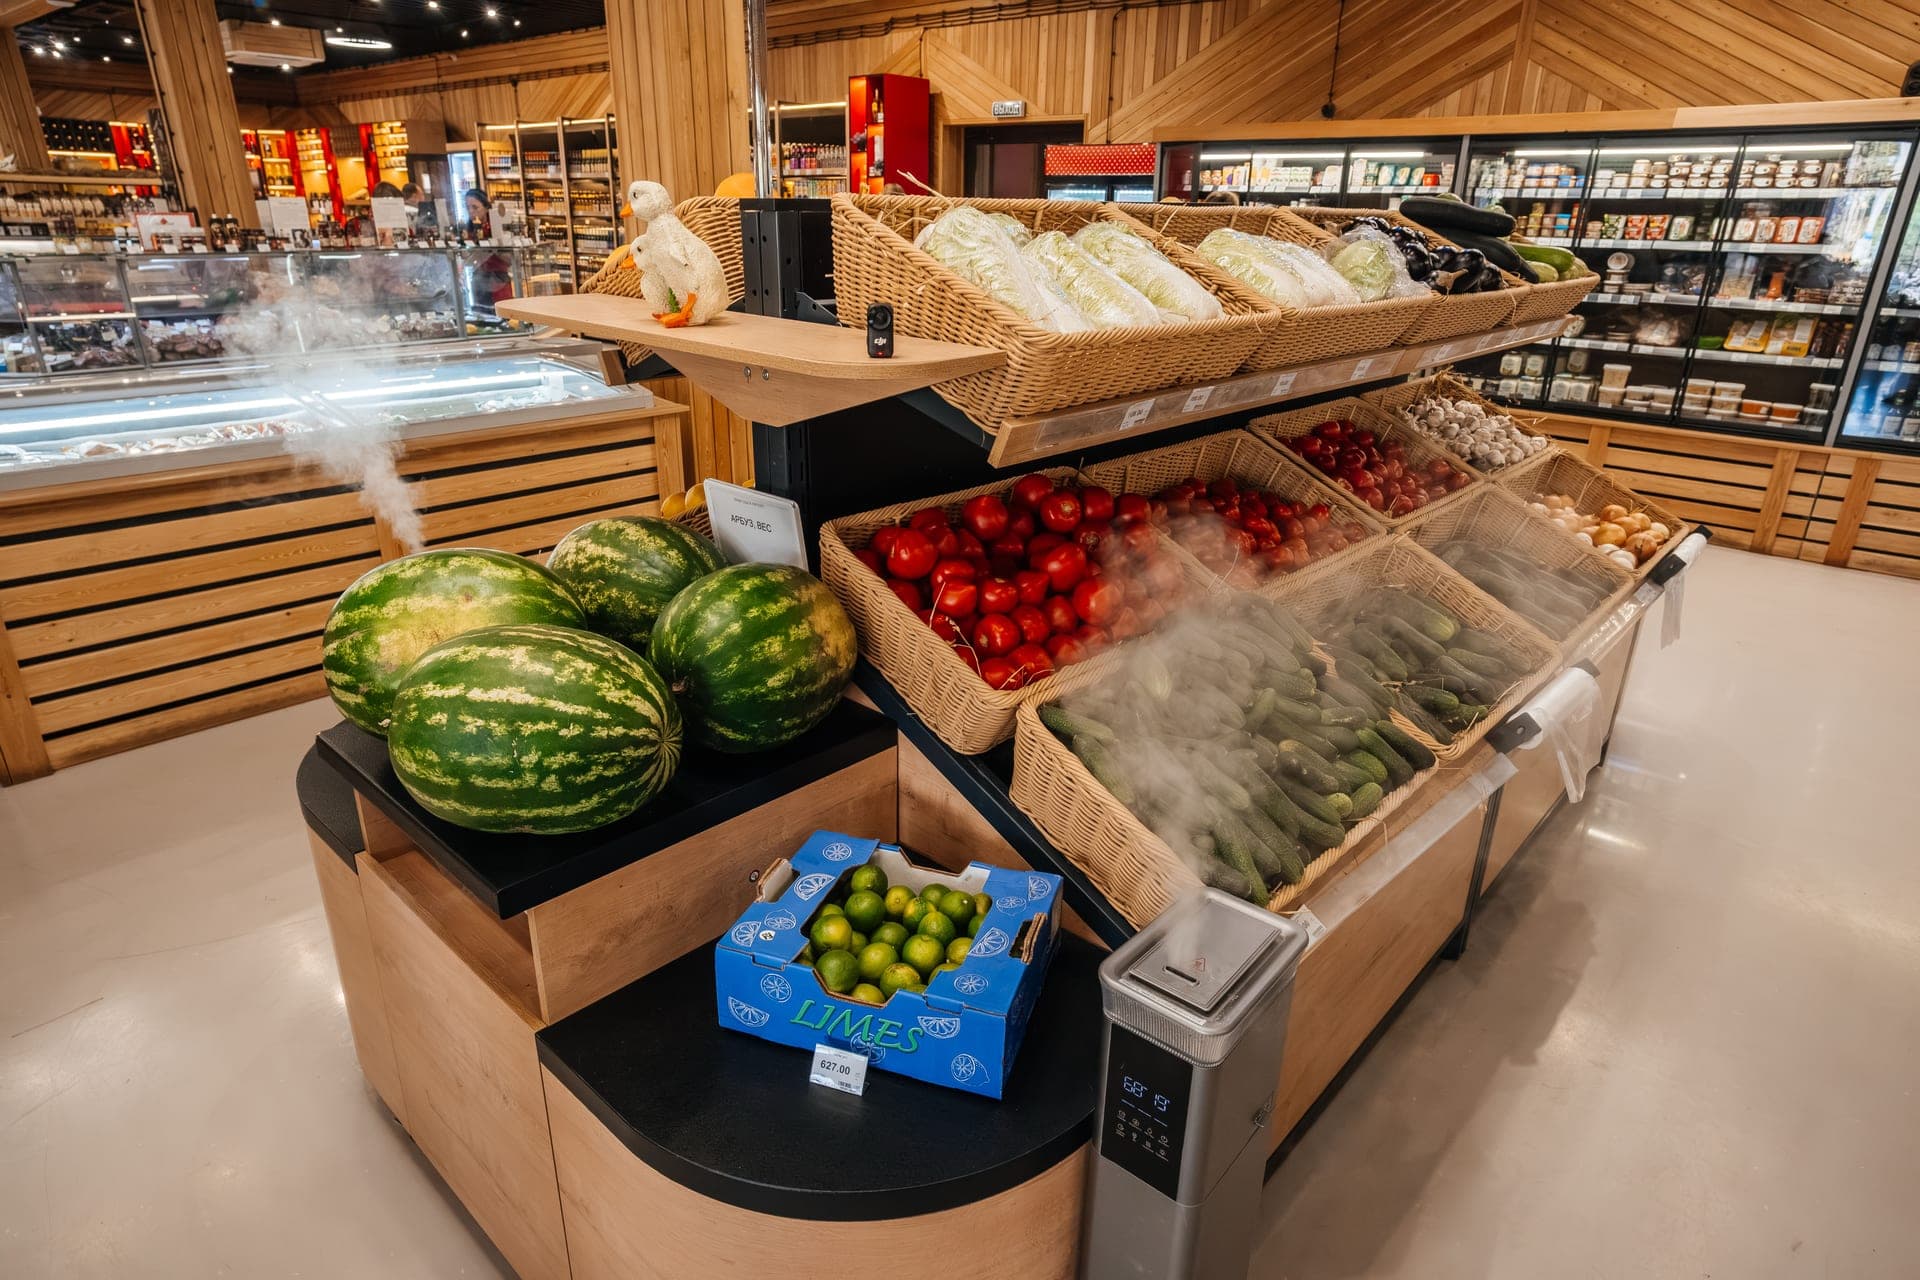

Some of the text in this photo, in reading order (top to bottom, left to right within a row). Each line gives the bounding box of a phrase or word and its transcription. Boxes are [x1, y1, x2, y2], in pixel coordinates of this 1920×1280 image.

[730, 514, 772, 533] АРБУЗ, ВЕС
[790, 999, 924, 1053] LIMES
[820, 1059, 851, 1075] 627.00
